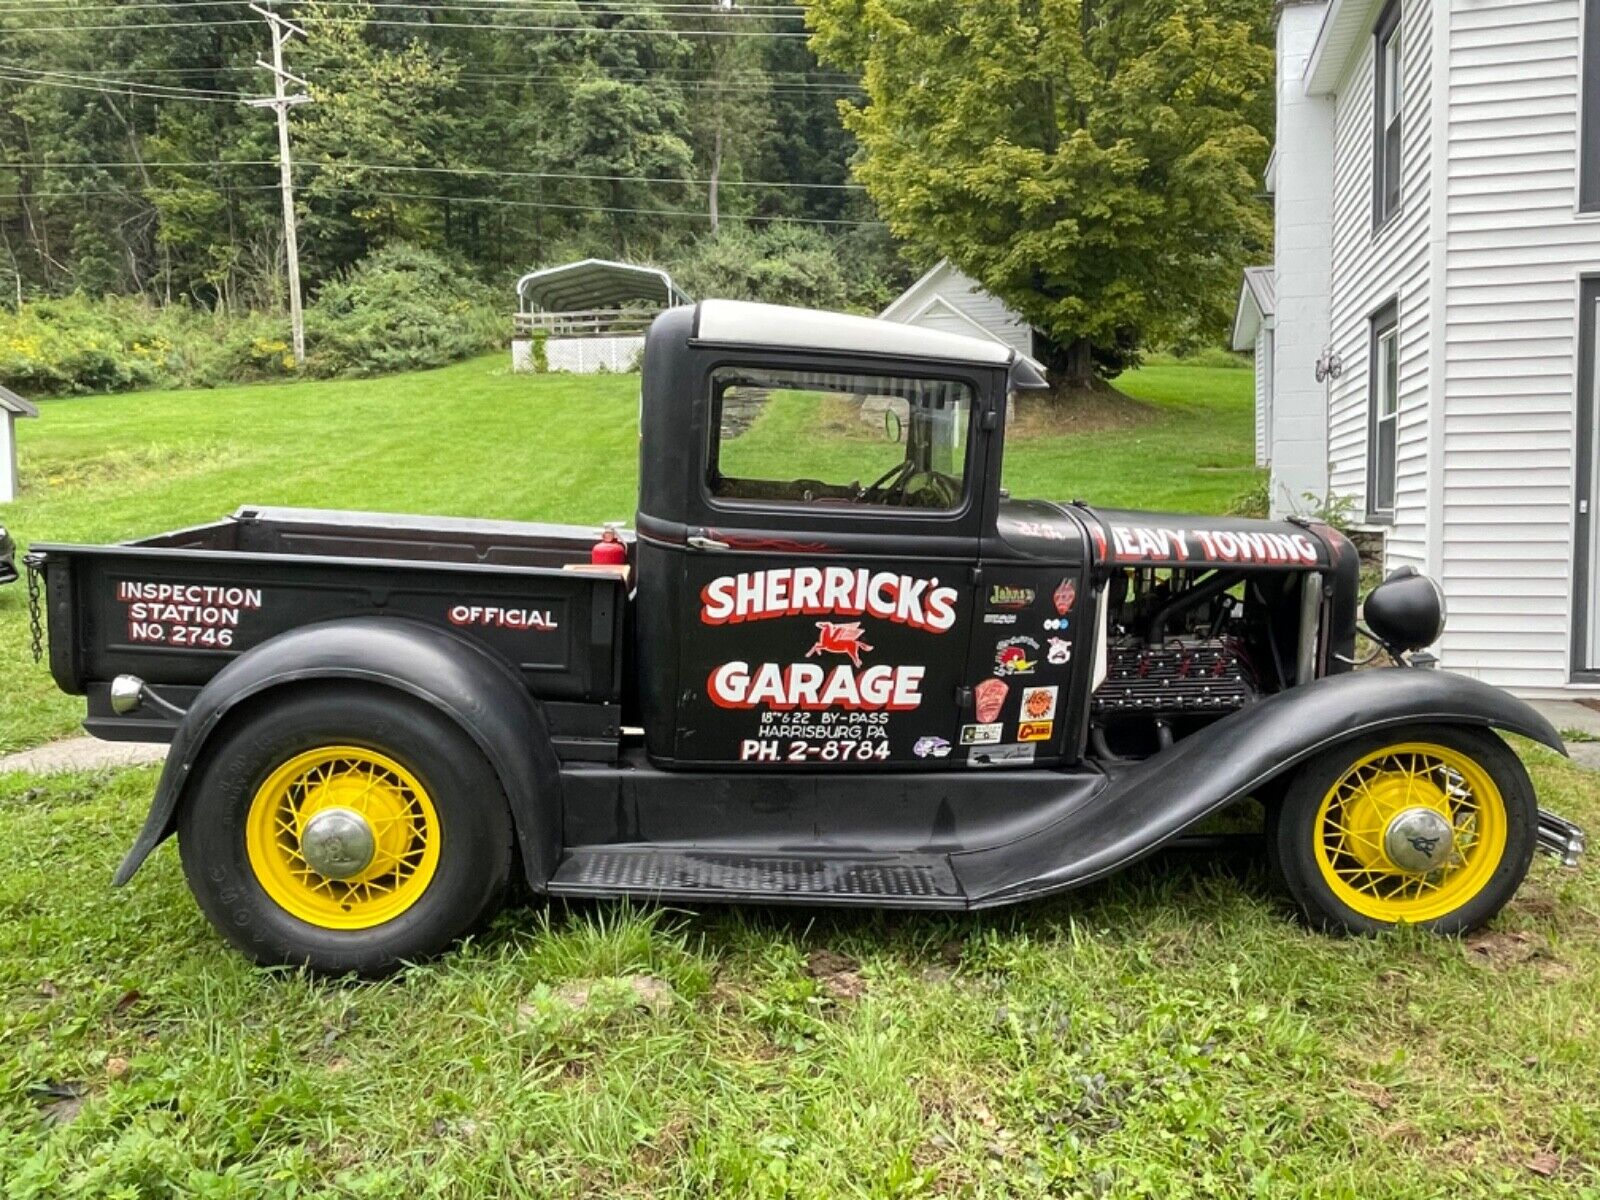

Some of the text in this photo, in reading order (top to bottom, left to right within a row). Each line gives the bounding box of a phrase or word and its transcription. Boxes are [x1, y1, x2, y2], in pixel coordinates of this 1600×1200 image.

[1193, 530, 1319, 563] TOWING
[120, 581, 262, 609] INSPECTION
[702, 566, 957, 632] SHERRICK'S
[130, 603, 241, 627] STATION
[450, 605, 558, 629] OFFICIAL
[131, 622, 234, 647] NO. 2746
[711, 661, 926, 709] GARAGE
[821, 712, 889, 725] BY-PASS
[741, 740, 891, 762] PH. 2-8784
